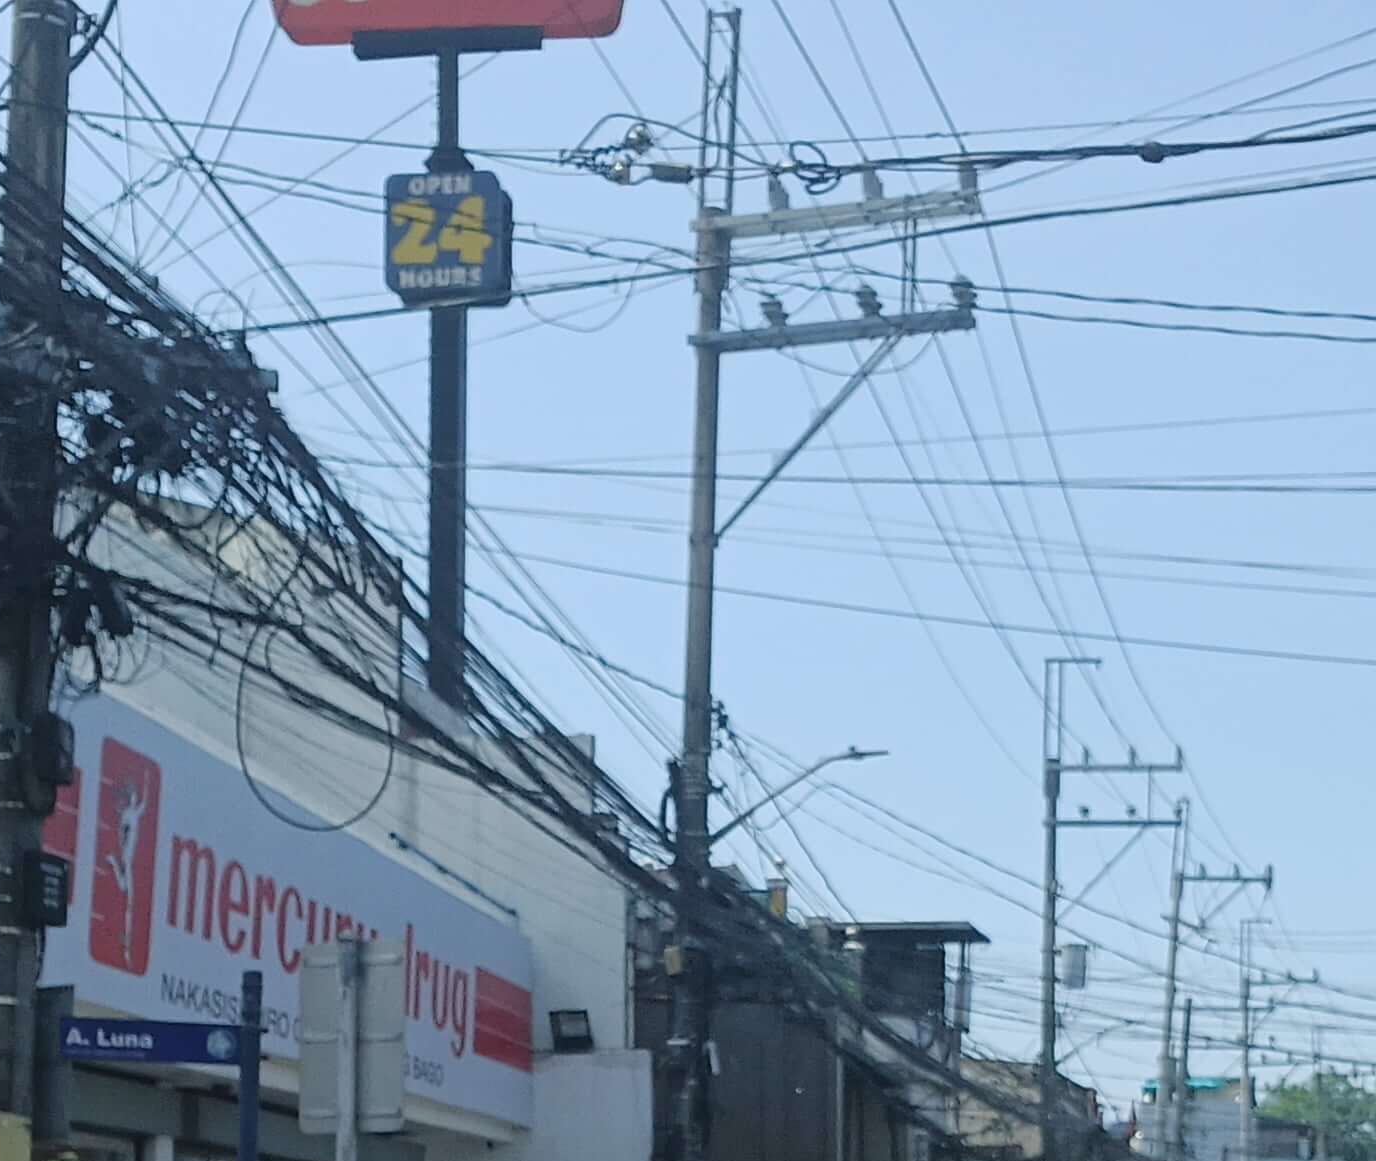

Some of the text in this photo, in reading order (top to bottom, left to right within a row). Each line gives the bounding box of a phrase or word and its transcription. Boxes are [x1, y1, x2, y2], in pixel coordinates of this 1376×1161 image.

[407, 174, 472, 196] OPEN
[390, 195, 493, 265] 24
[398, 266, 482, 289] HOURS
[167, 832, 469, 1059] merc rug
[65, 1026, 154, 1050] A. Luna
